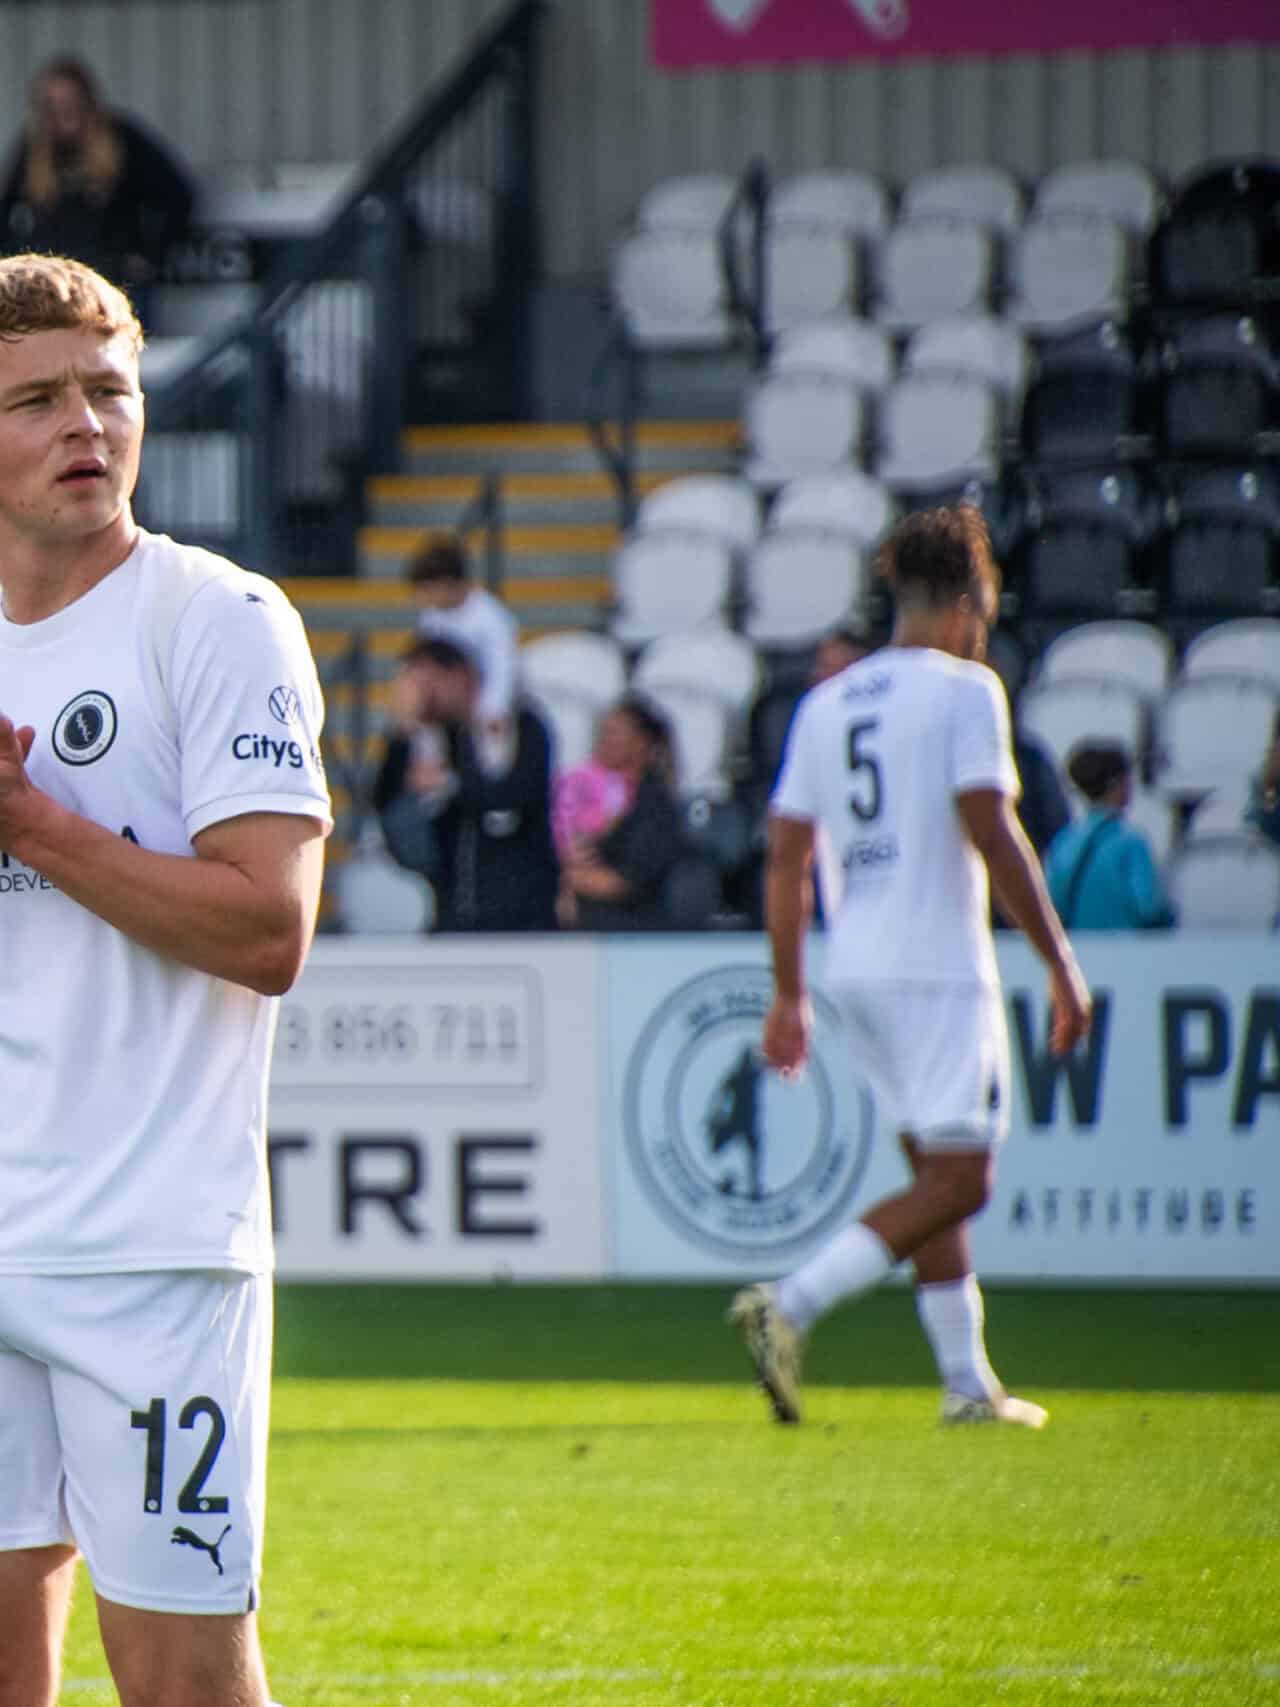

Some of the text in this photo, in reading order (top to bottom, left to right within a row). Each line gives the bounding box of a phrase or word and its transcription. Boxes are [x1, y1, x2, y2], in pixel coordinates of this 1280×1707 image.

[232, 733, 320, 770] Cityg
[849, 716, 882, 822] 5
[1011, 989, 1280, 1128] W PA
[1009, 1186, 1258, 1234] ATTITUDE
[131, 1396, 229, 1514] 12
